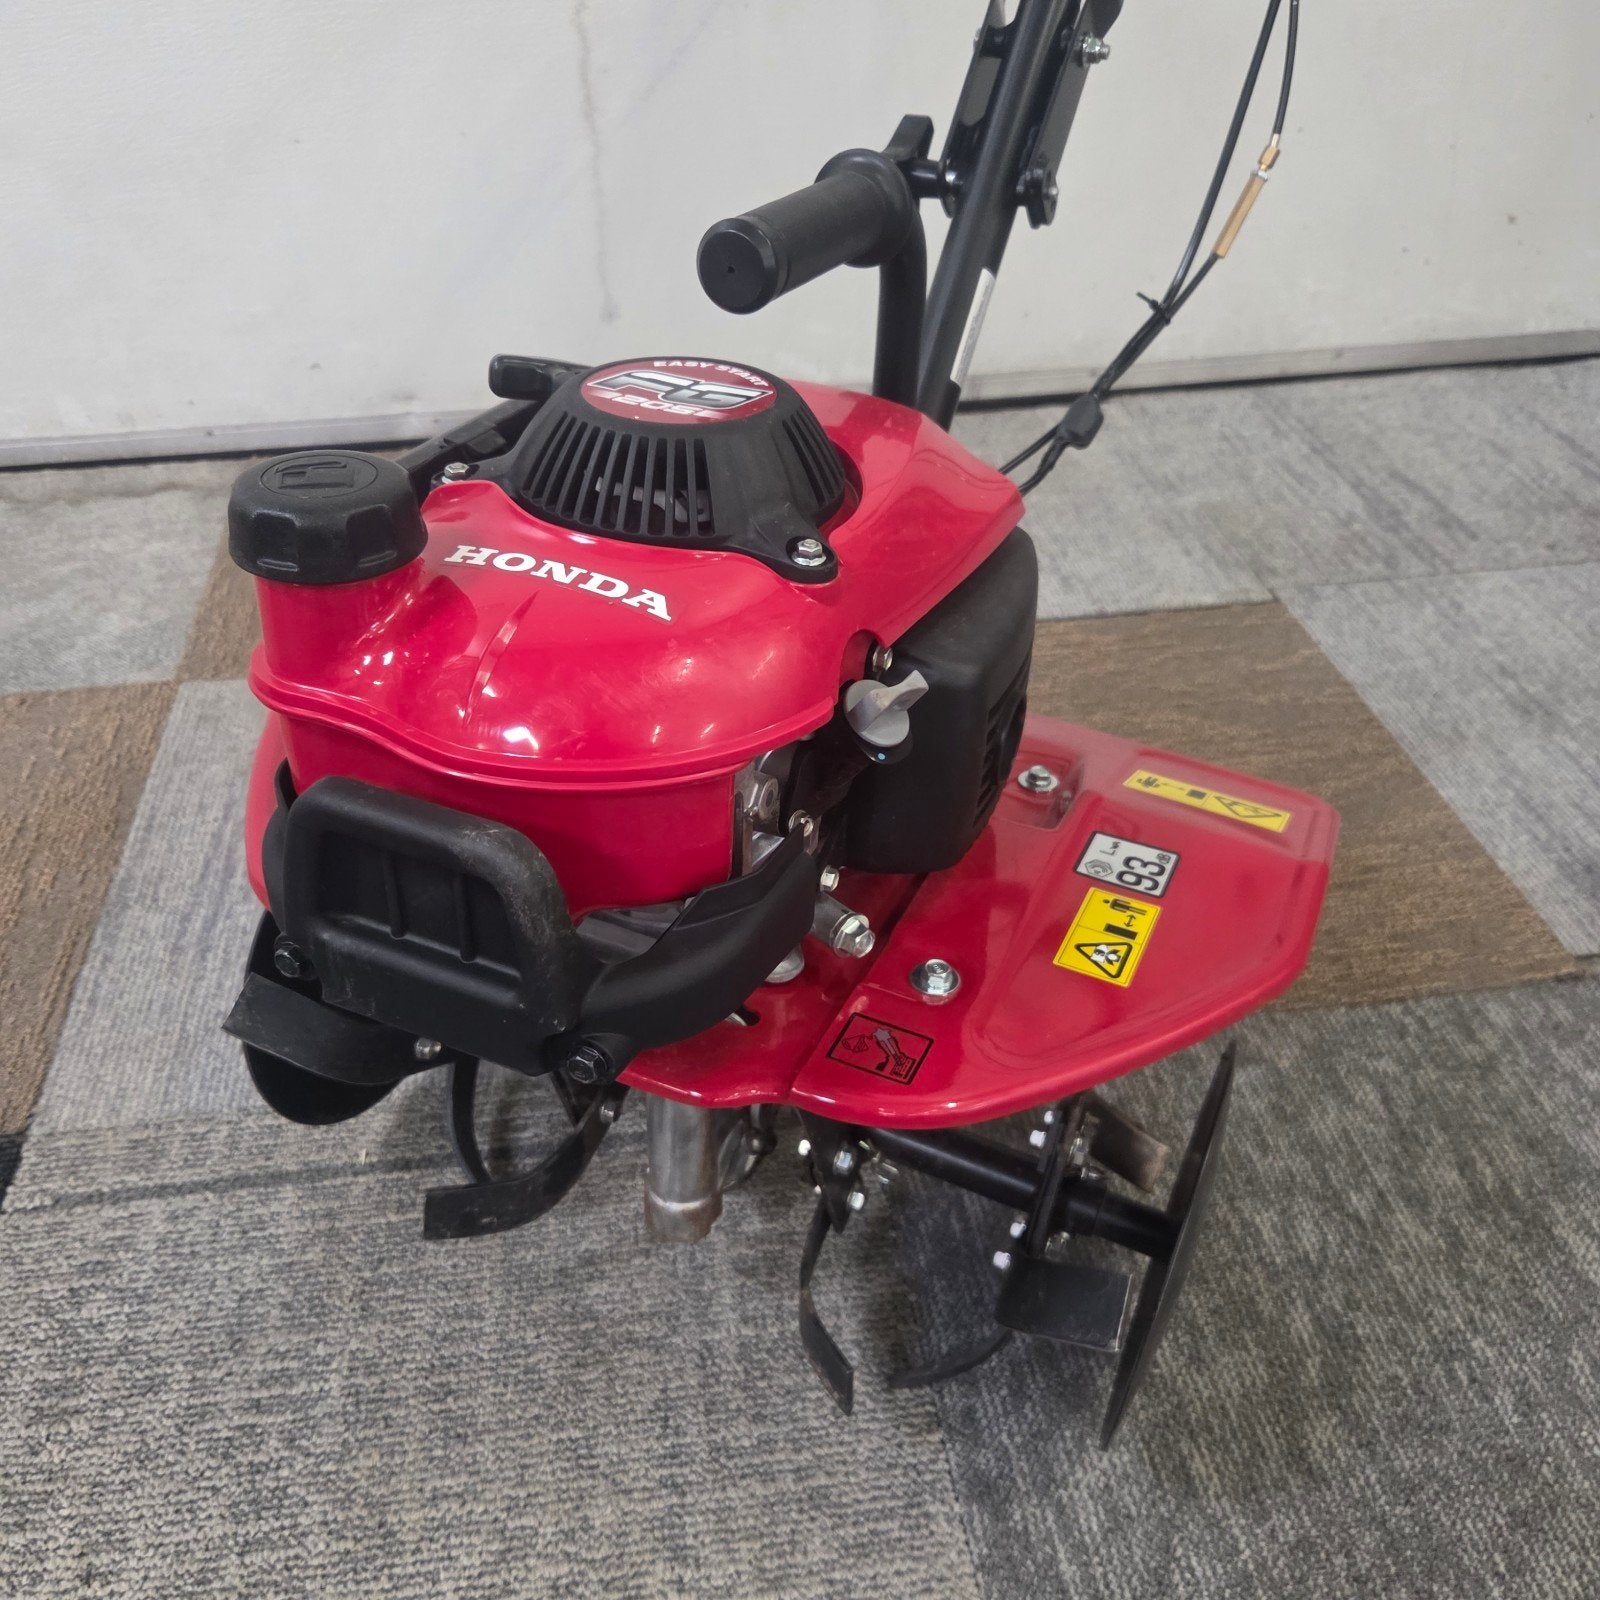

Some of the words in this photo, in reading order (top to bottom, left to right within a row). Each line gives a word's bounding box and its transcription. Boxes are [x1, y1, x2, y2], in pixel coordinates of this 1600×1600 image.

[653, 360, 714, 368] EASY
[717, 365, 768, 386] START
[444, 544, 672, 621] HONDA
[1116, 856, 1166, 891] 93
